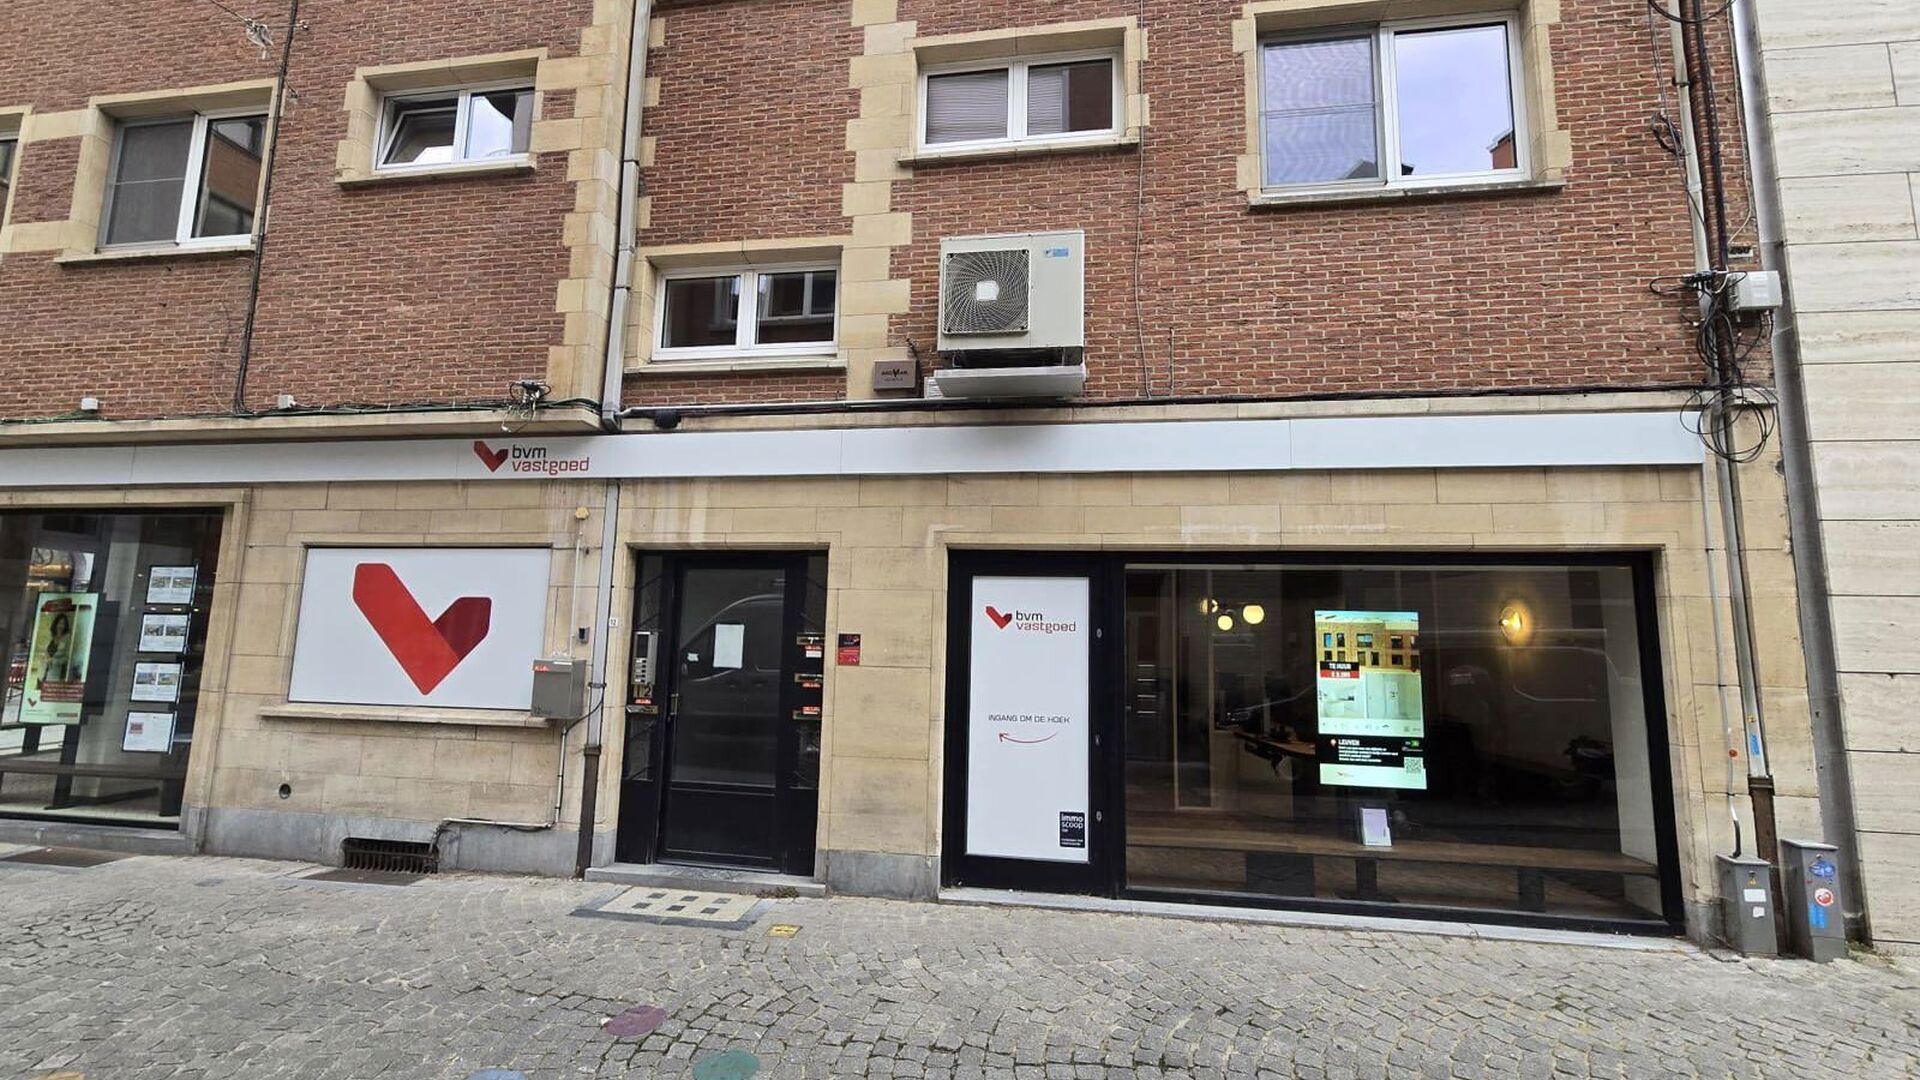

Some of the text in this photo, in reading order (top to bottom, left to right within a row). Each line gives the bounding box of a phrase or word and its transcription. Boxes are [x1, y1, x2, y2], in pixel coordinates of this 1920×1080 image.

[512, 444, 547, 459] bvm
[512, 457, 590, 476] vastgoed
[1015, 610, 1043, 621] bvm
[1016, 621, 1076, 634] vastgoed
[988, 714, 1018, 722] INGANG
[1019, 714, 1033, 722] OM
[1034, 715, 1046, 723] DE
[1061, 821, 1084, 829] scoop
